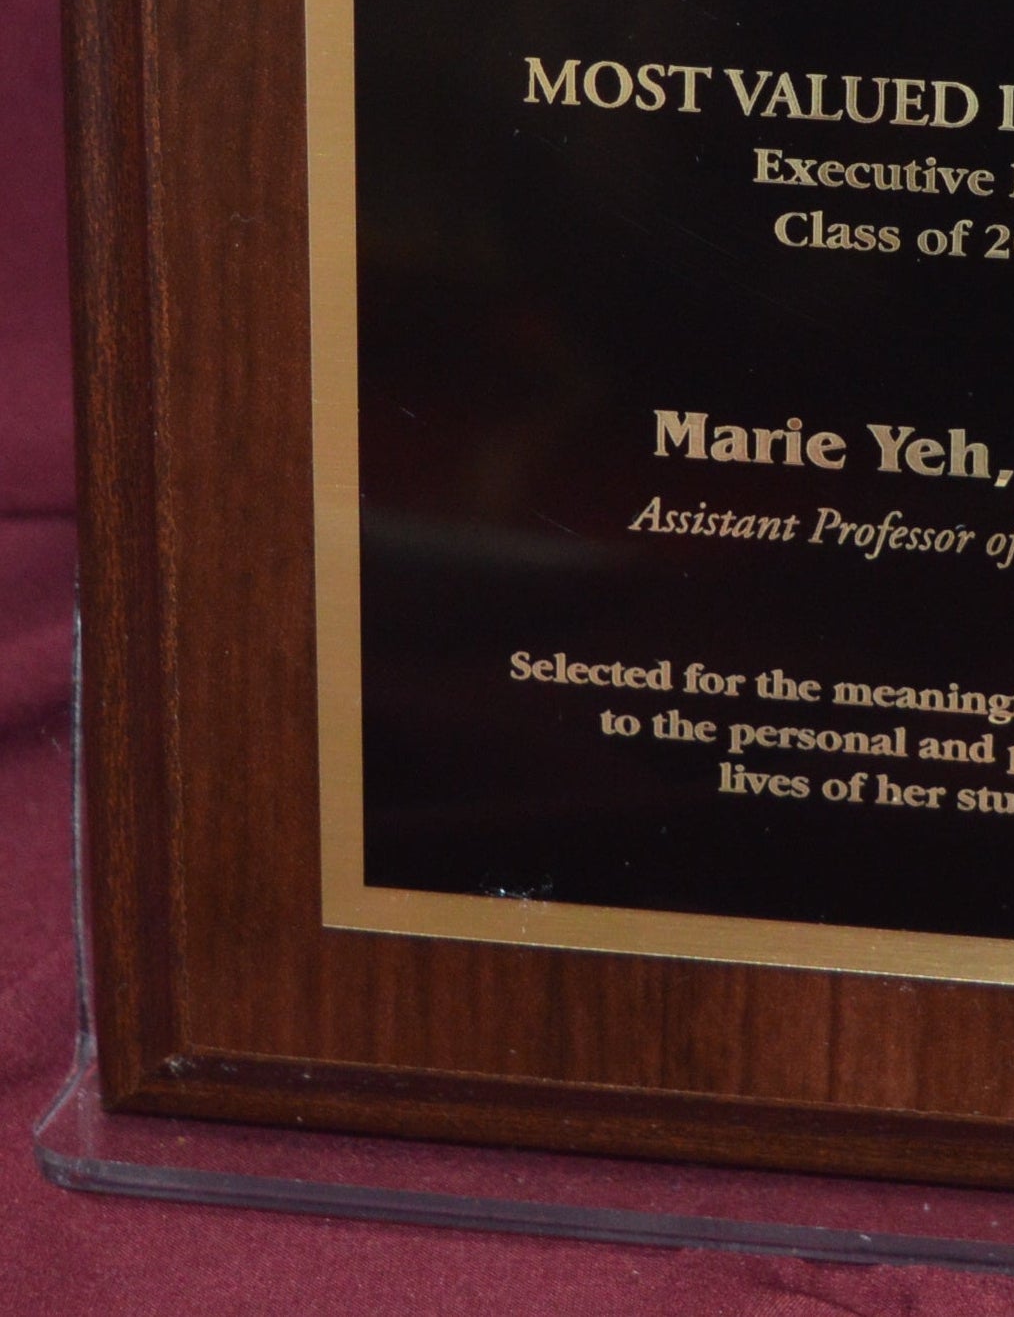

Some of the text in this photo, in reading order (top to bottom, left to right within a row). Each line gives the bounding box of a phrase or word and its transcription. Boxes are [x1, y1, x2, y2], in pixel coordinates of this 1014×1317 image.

[524, 57, 712, 112] MOST
[724, 69, 979, 128] VALUED
[753, 149, 994, 195] Executive
[775, 211, 900, 252] Class
[918, 220, 973, 256] of
[654, 410, 846, 469] Marie
[867, 424, 1013, 487] Yeh,
[628, 497, 799, 541] Assistant
[808, 508, 975, 559] Professor
[511, 652, 672, 690] Selected
[683, 663, 745, 695] for
[755, 669, 821, 701] the
[601, 710, 640, 736] to
[652, 710, 716, 742] the
[729, 724, 907, 756] personal
[919, 734, 995, 763] and
[719, 762, 809, 797] lives
[822, 773, 868, 801] of
[876, 774, 946, 808] her
